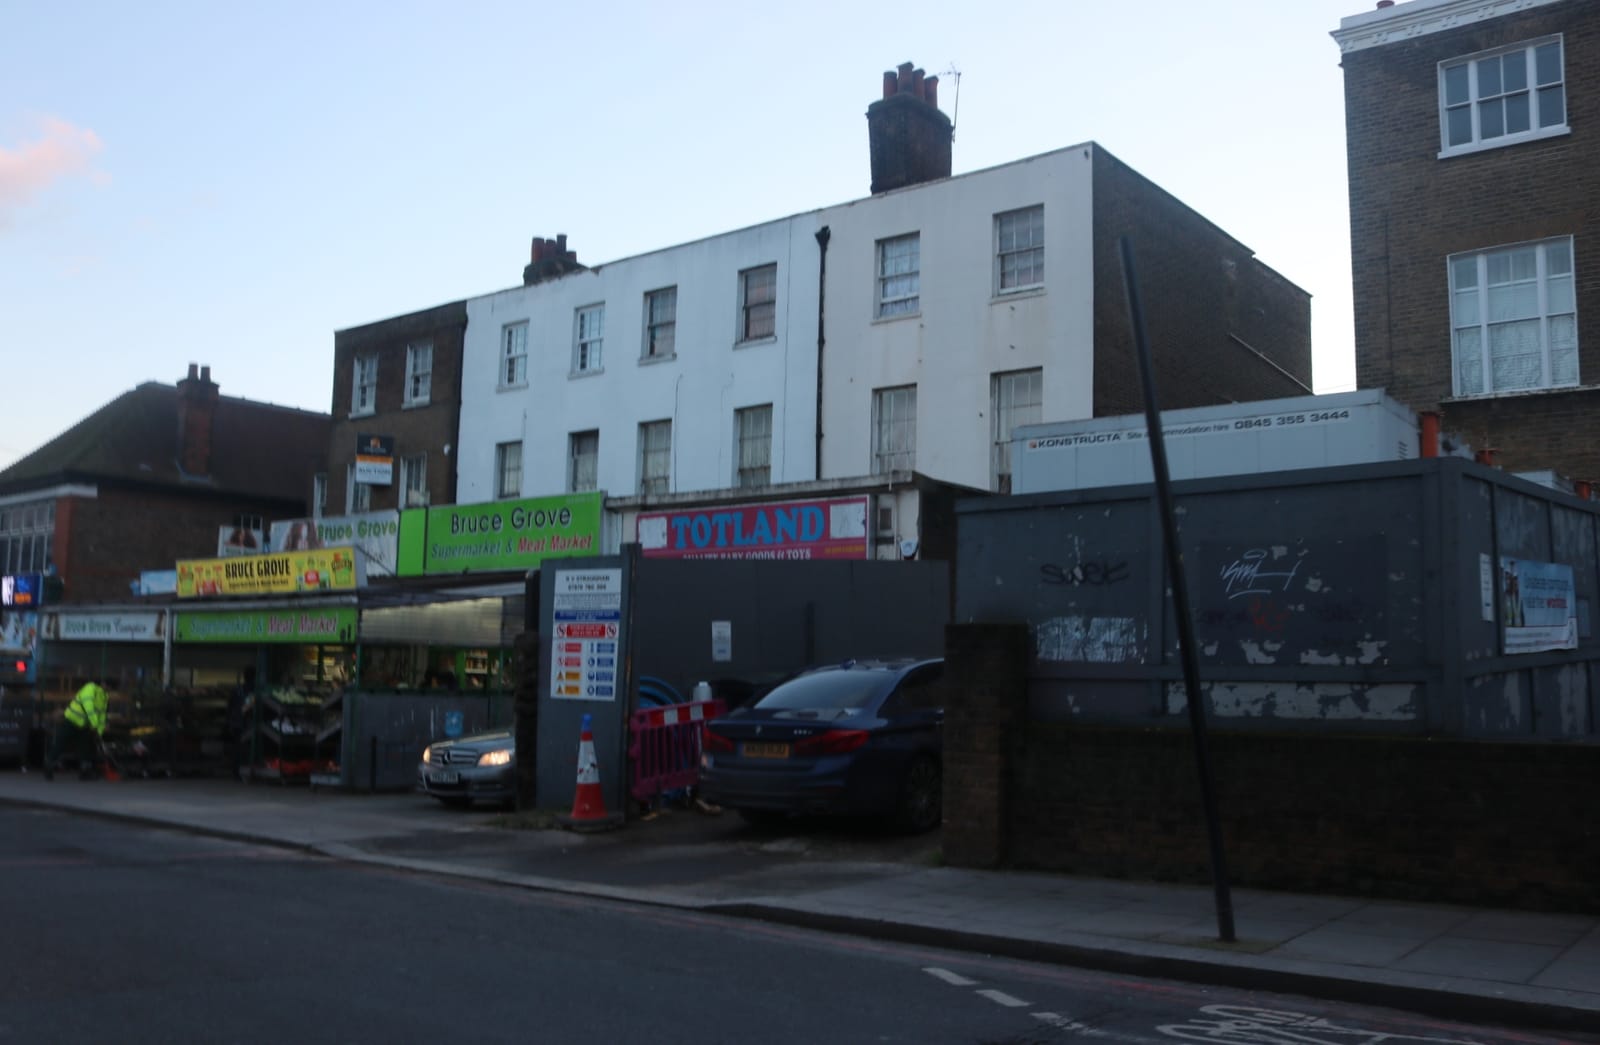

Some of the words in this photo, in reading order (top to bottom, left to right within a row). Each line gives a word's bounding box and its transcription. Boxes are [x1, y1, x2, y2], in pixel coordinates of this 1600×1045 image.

[1038, 433, 1120, 448] KONSTRUCTA
[1234, 417, 1273, 431] 0845
[1277, 413, 1306, 426] 355
[1309, 410, 1350, 424] 3444
[357, 519, 397, 539] Grove
[451, 512, 503, 536] Bruce
[511, 506, 572, 530] Grove
[672, 505, 825, 550] TOTLAND
[431, 539, 502, 561] Supermarket
[505, 540, 513, 554] &
[517, 535, 547, 554] Meat
[550, 532, 593, 553] Market
[786, 547, 812, 560] TOYS
[225, 560, 255, 579] BRUCE
[257, 557, 291, 577] GROVE
[299, 611, 338, 634] Market
